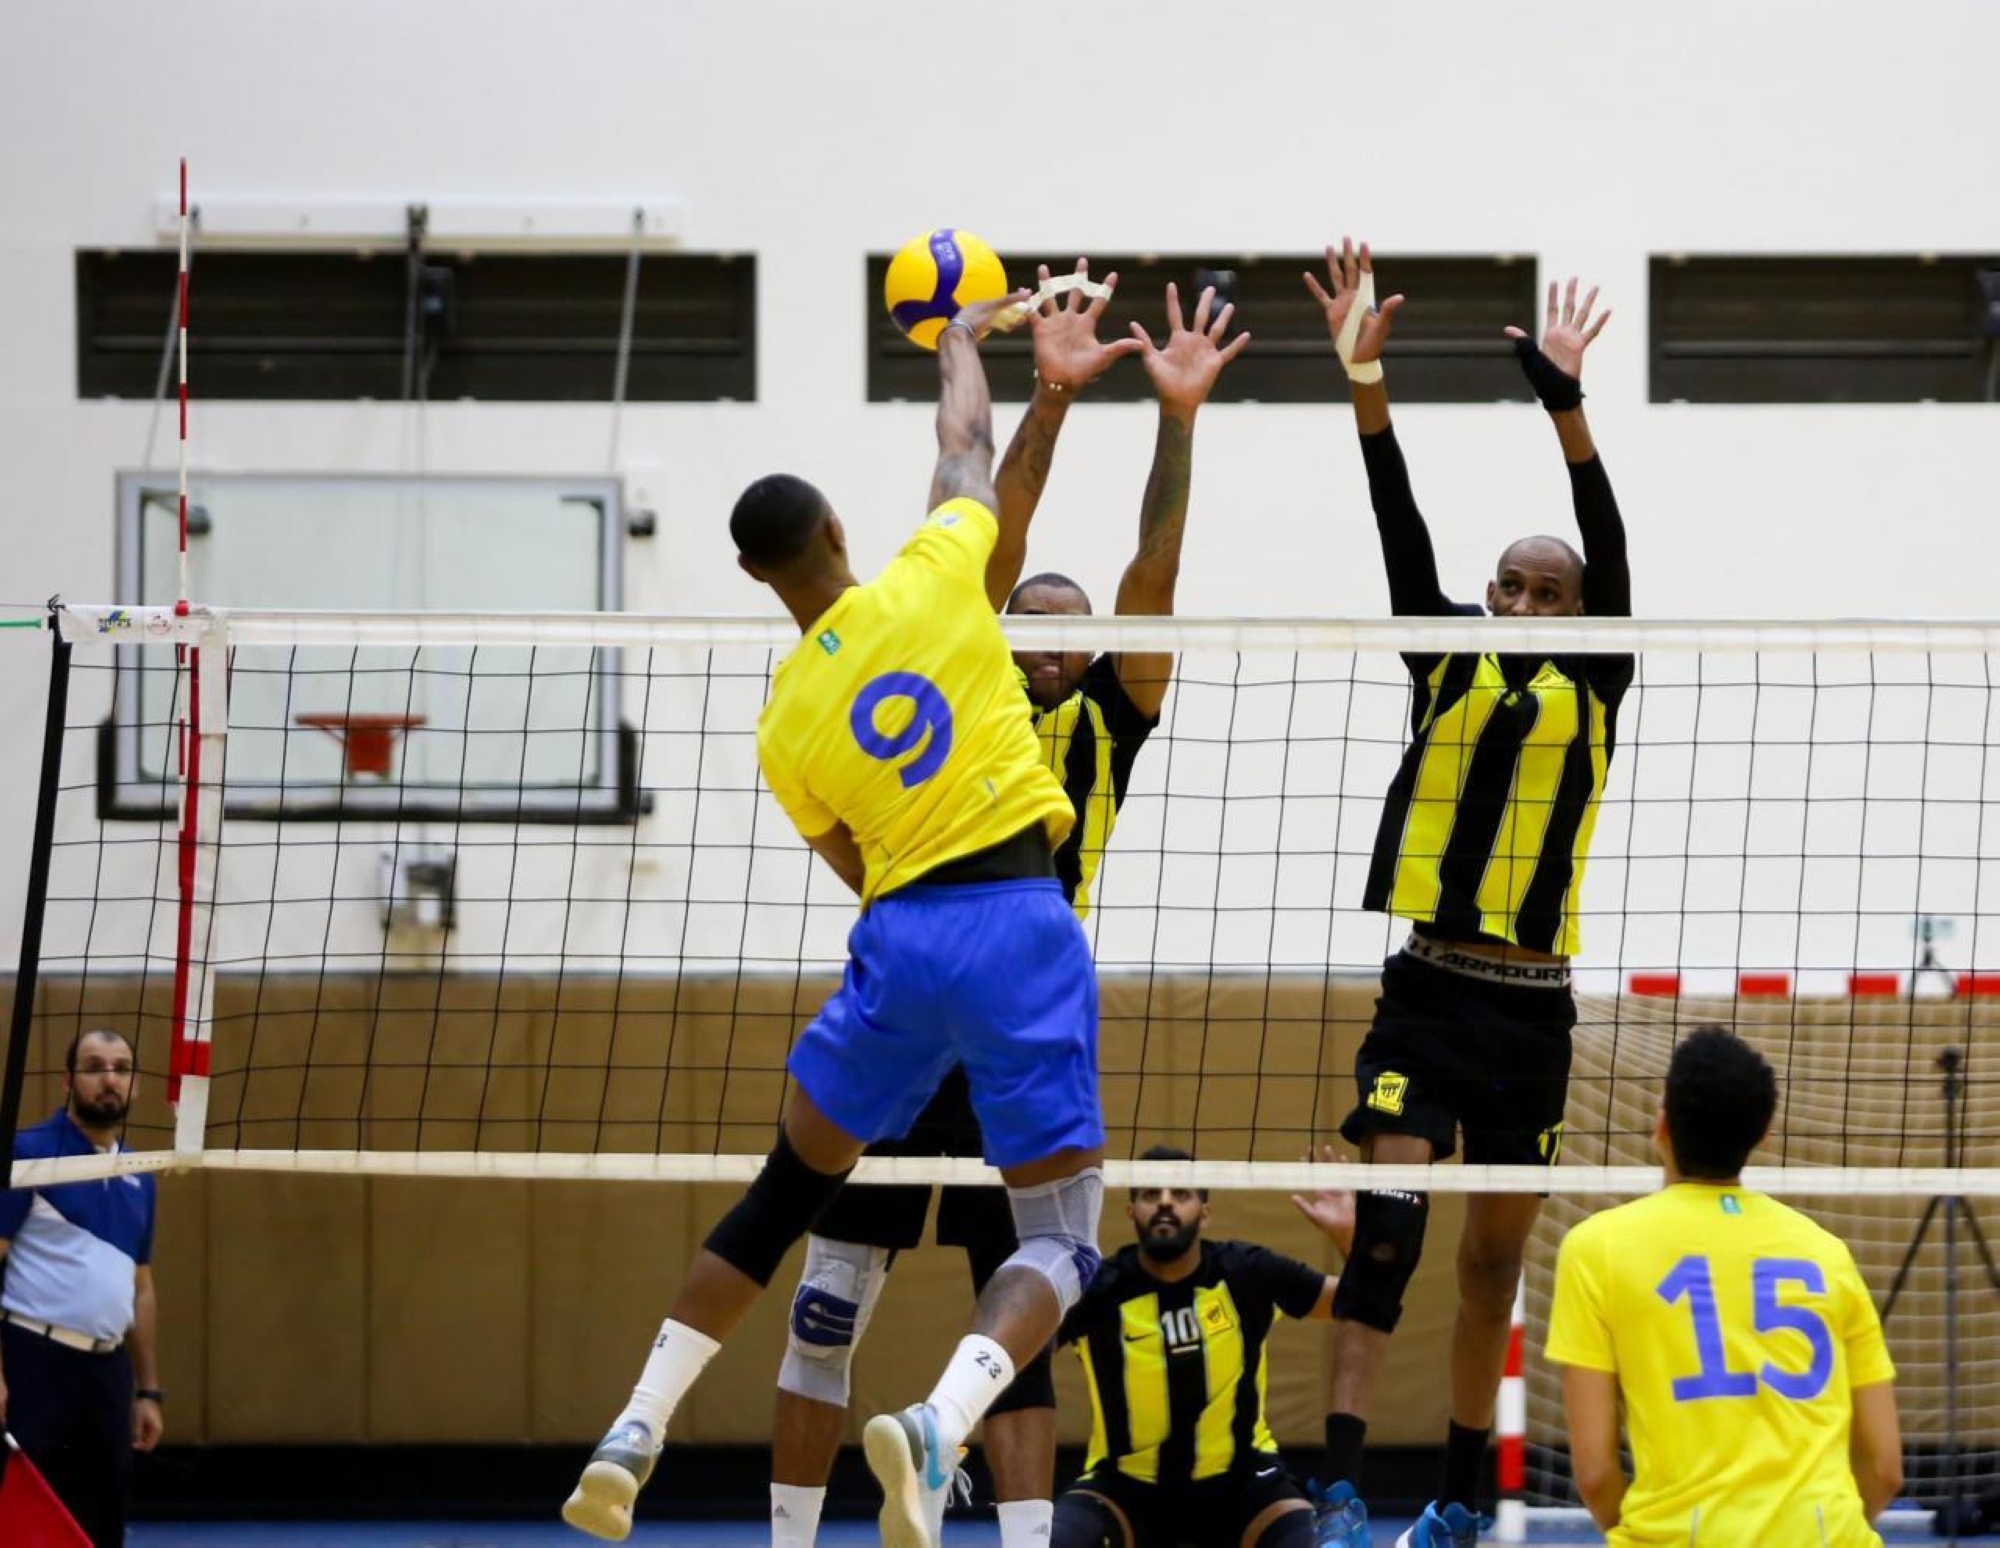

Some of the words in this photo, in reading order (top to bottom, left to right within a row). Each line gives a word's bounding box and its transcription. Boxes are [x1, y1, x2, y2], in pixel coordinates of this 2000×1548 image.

[851, 671, 953, 789] 9
[1435, 952, 1565, 981] ARMOUR
[1161, 1307, 1199, 1347] 10
[1655, 1255, 1834, 1402] 15
[973, 1351, 1002, 1379] 23
